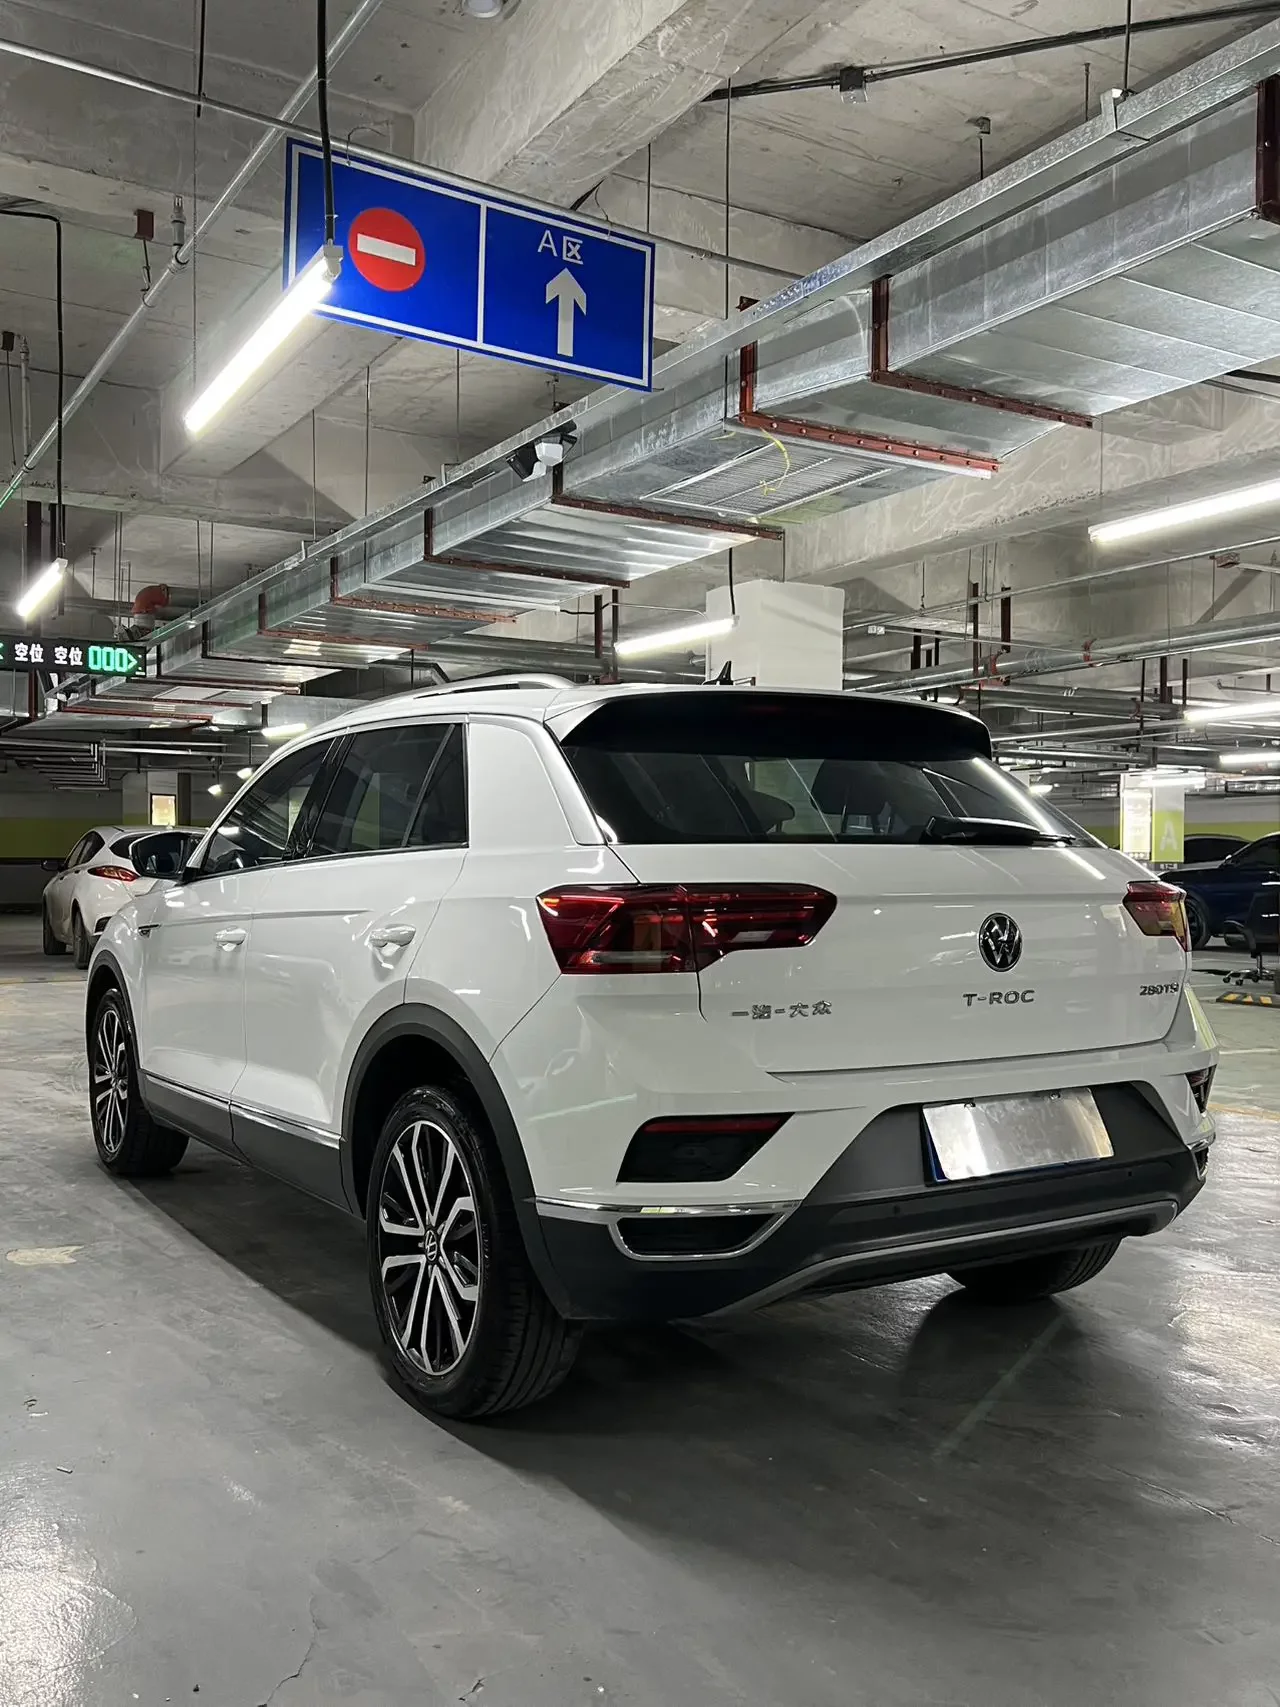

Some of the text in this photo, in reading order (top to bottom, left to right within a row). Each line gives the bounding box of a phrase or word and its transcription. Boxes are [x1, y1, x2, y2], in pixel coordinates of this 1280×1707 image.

[537, 229, 584, 265] A区
[14, 643, 128, 672] 空位 空位 000
[963, 989, 1036, 1007] T-ROC
